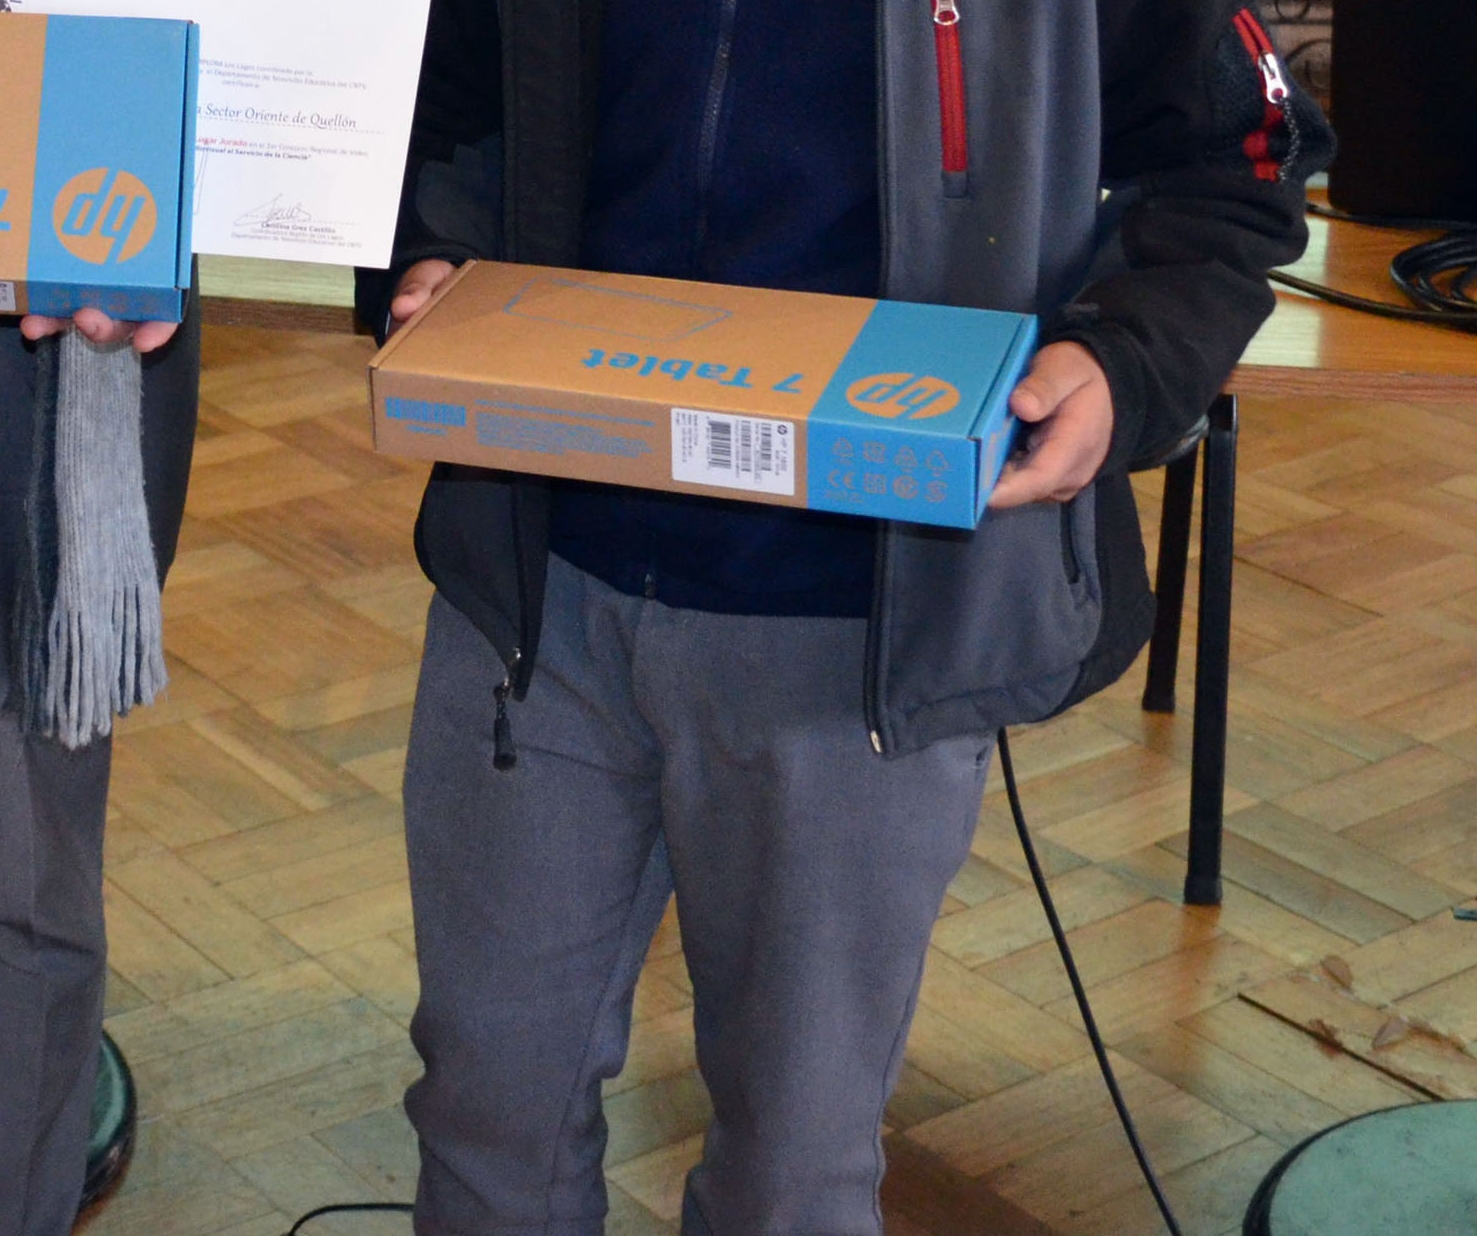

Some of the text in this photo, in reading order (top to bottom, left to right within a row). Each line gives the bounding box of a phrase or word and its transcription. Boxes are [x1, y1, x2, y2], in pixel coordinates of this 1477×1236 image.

[205, 102, 242, 118] Sector
[245, 107, 289, 123] Oriente
[292, 109, 307, 124] de
[310, 112, 356, 130] Quellón
[60, 168, 148, 264] hp
[579, 347, 805, 394] 7 Tablet
[848, 373, 958, 419] hp
